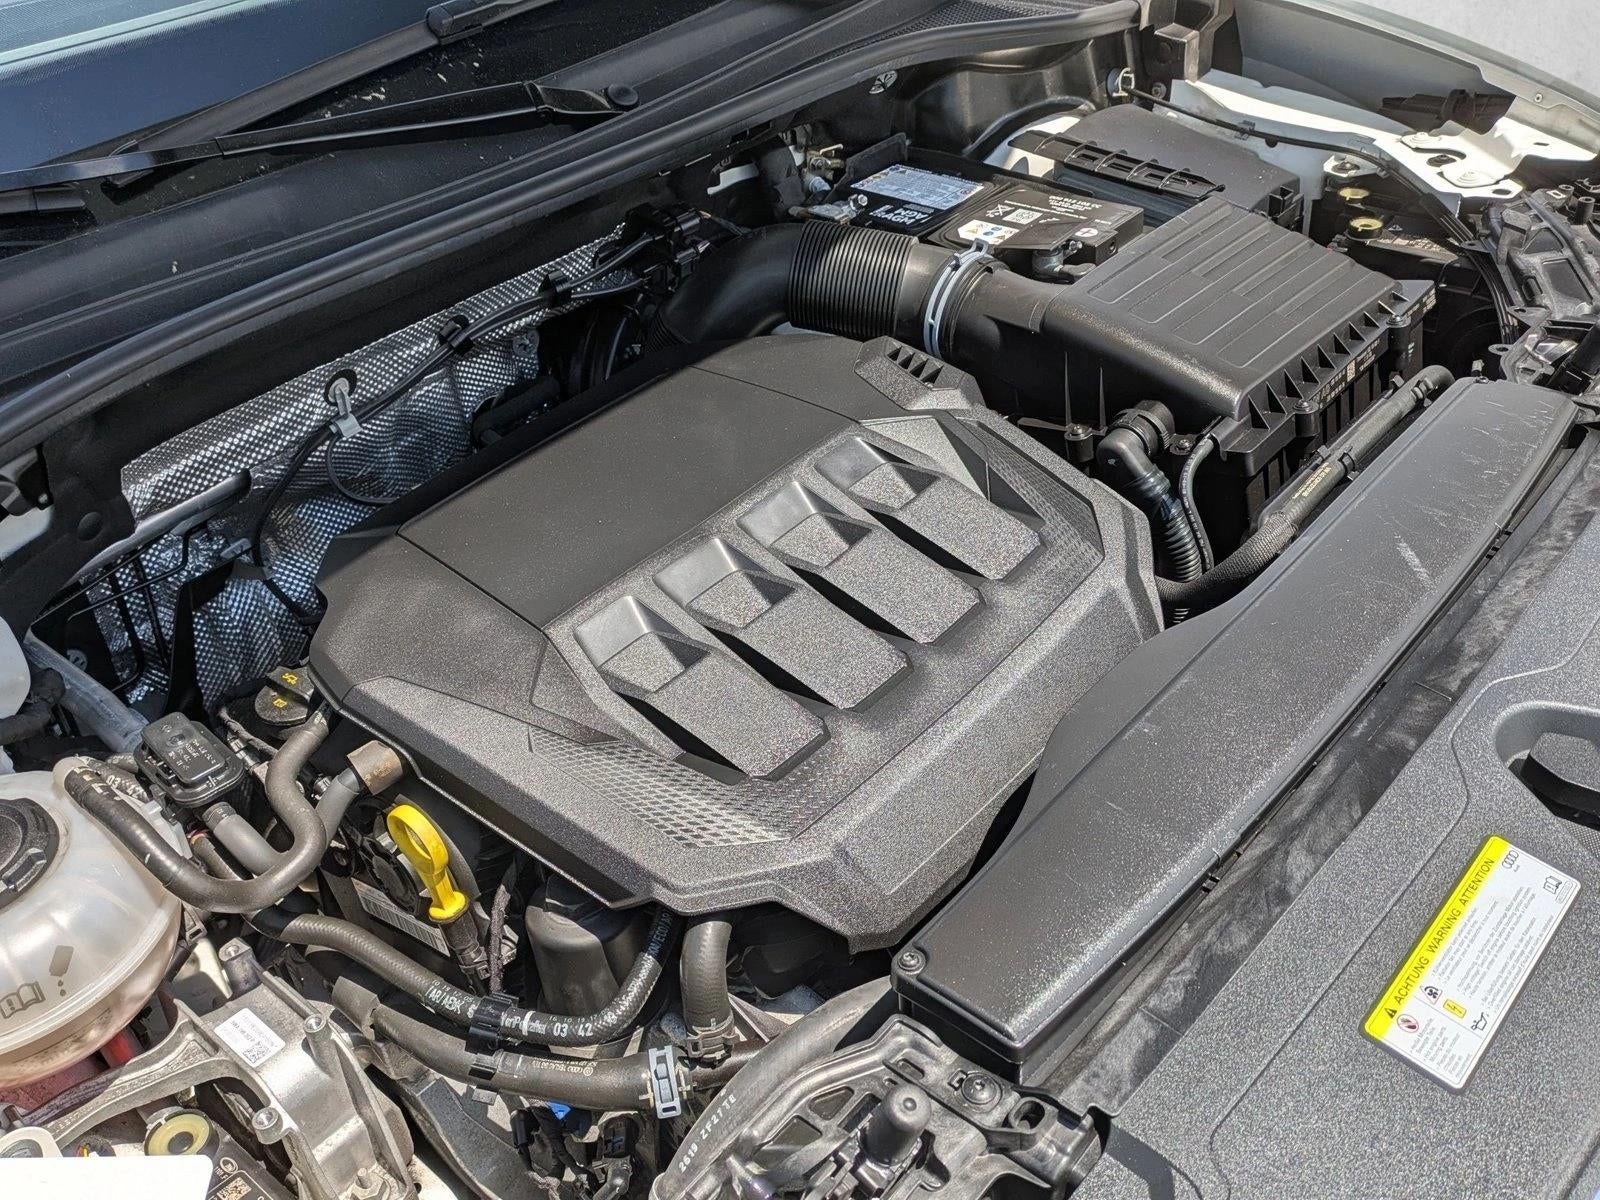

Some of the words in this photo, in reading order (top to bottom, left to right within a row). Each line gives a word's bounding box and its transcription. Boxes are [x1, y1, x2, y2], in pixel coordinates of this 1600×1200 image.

[1392, 955, 1430, 1004] ACHTUNG
[1425, 907, 1461, 954] WARNING
[1457, 857, 1495, 906] ATTENTION
[553, 1023, 568, 1037] 03
[578, 1023, 593, 1037] 42
